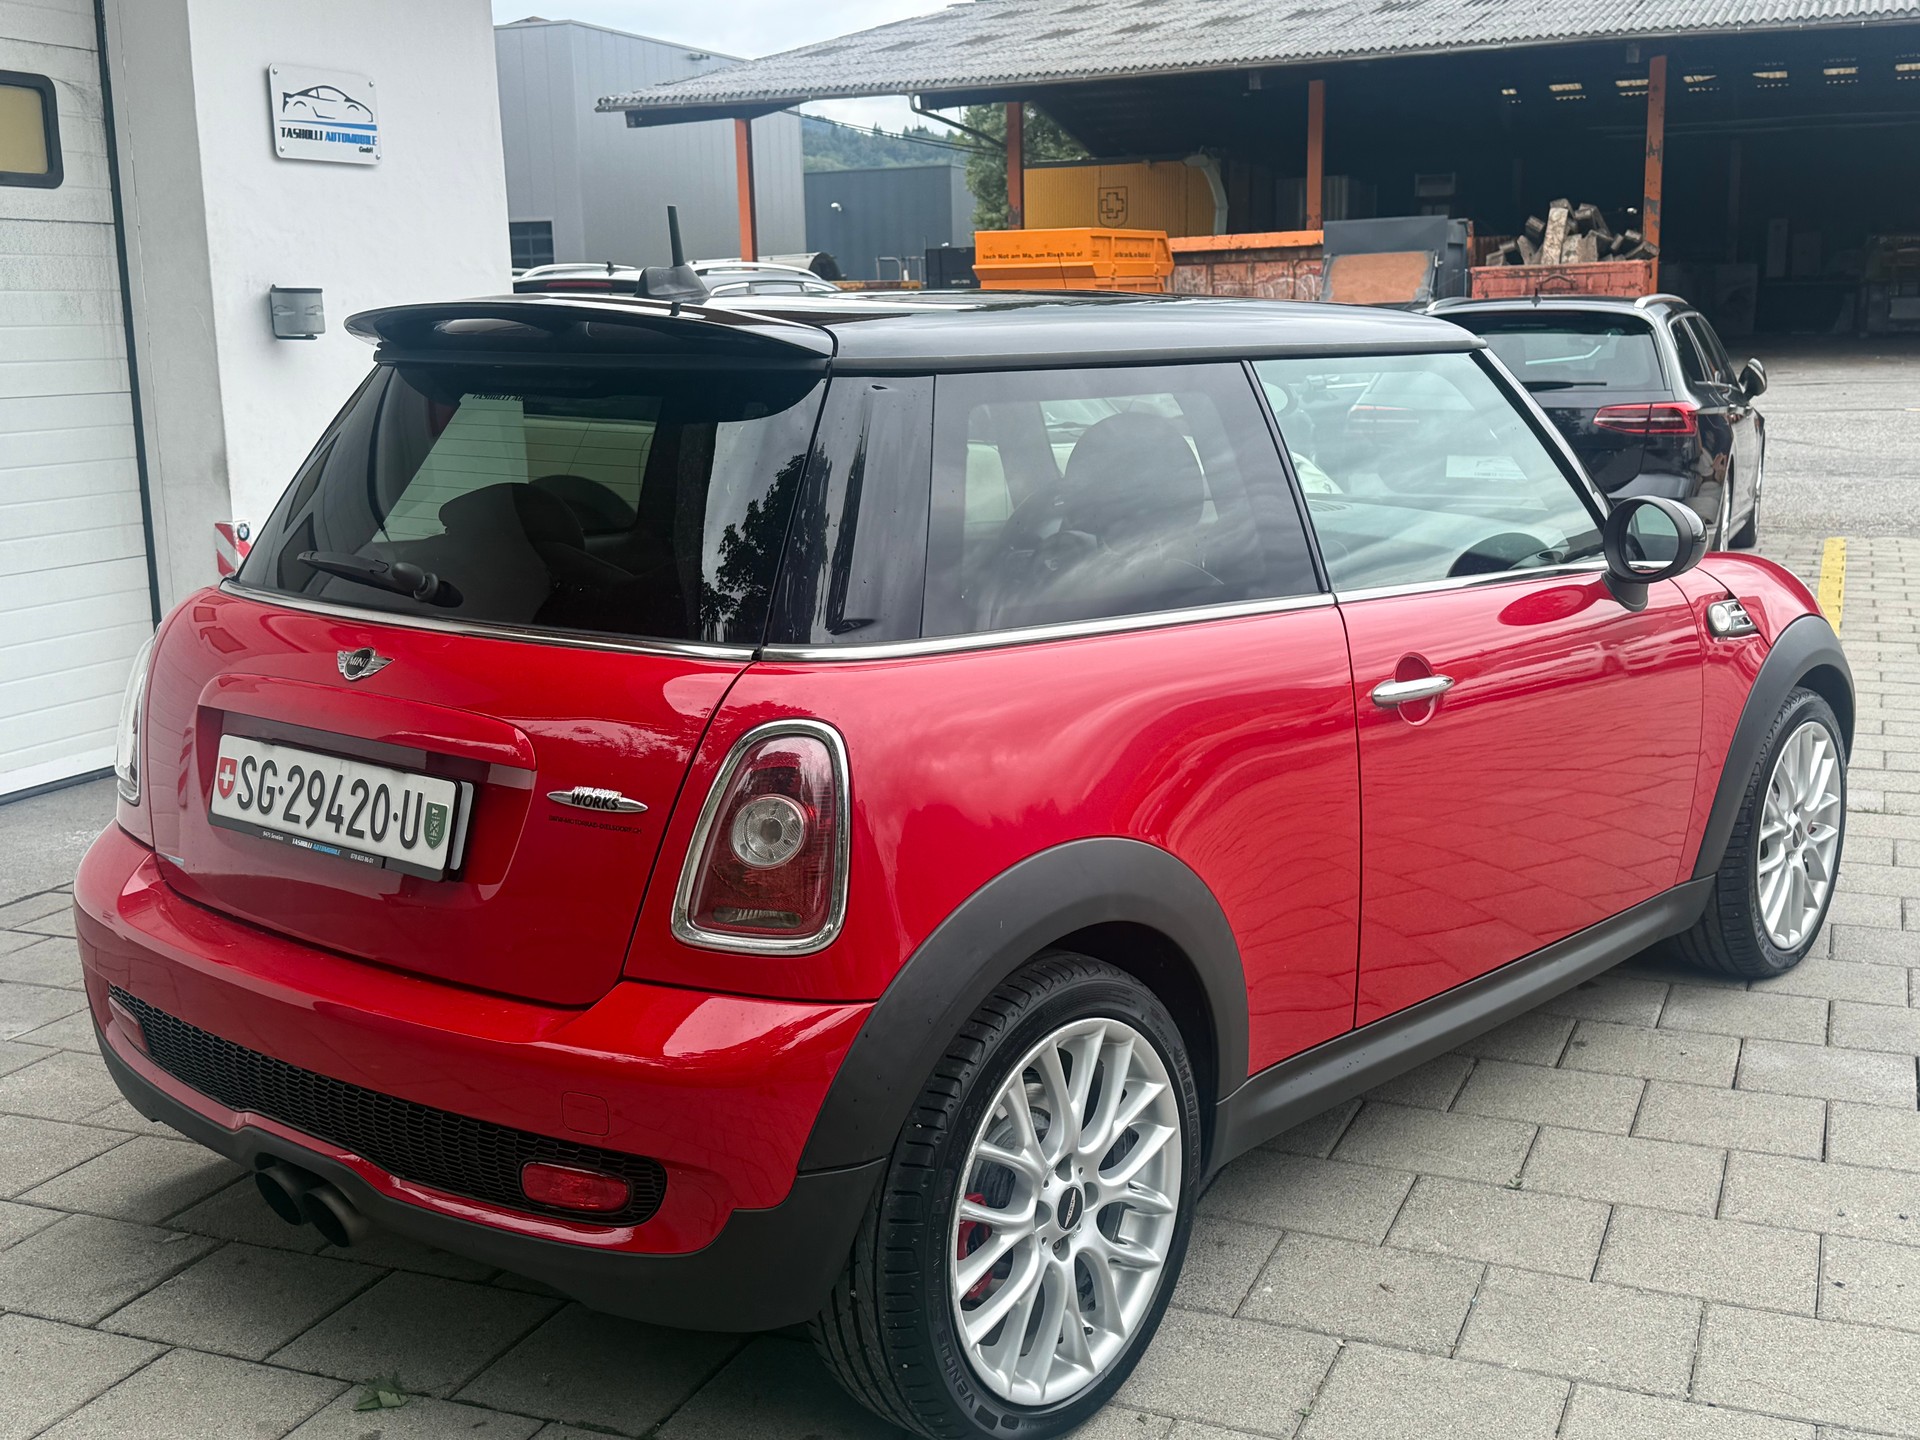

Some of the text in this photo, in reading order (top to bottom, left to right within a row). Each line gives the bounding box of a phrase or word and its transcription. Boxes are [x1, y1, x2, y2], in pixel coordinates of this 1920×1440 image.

[281, 127, 377, 145] TASHOLLI AUTOMOBILE
[349, 657, 368, 667] MINI
[571, 793, 619, 809] WORKS
[313, 845, 341, 855] AUTOMOBILE
